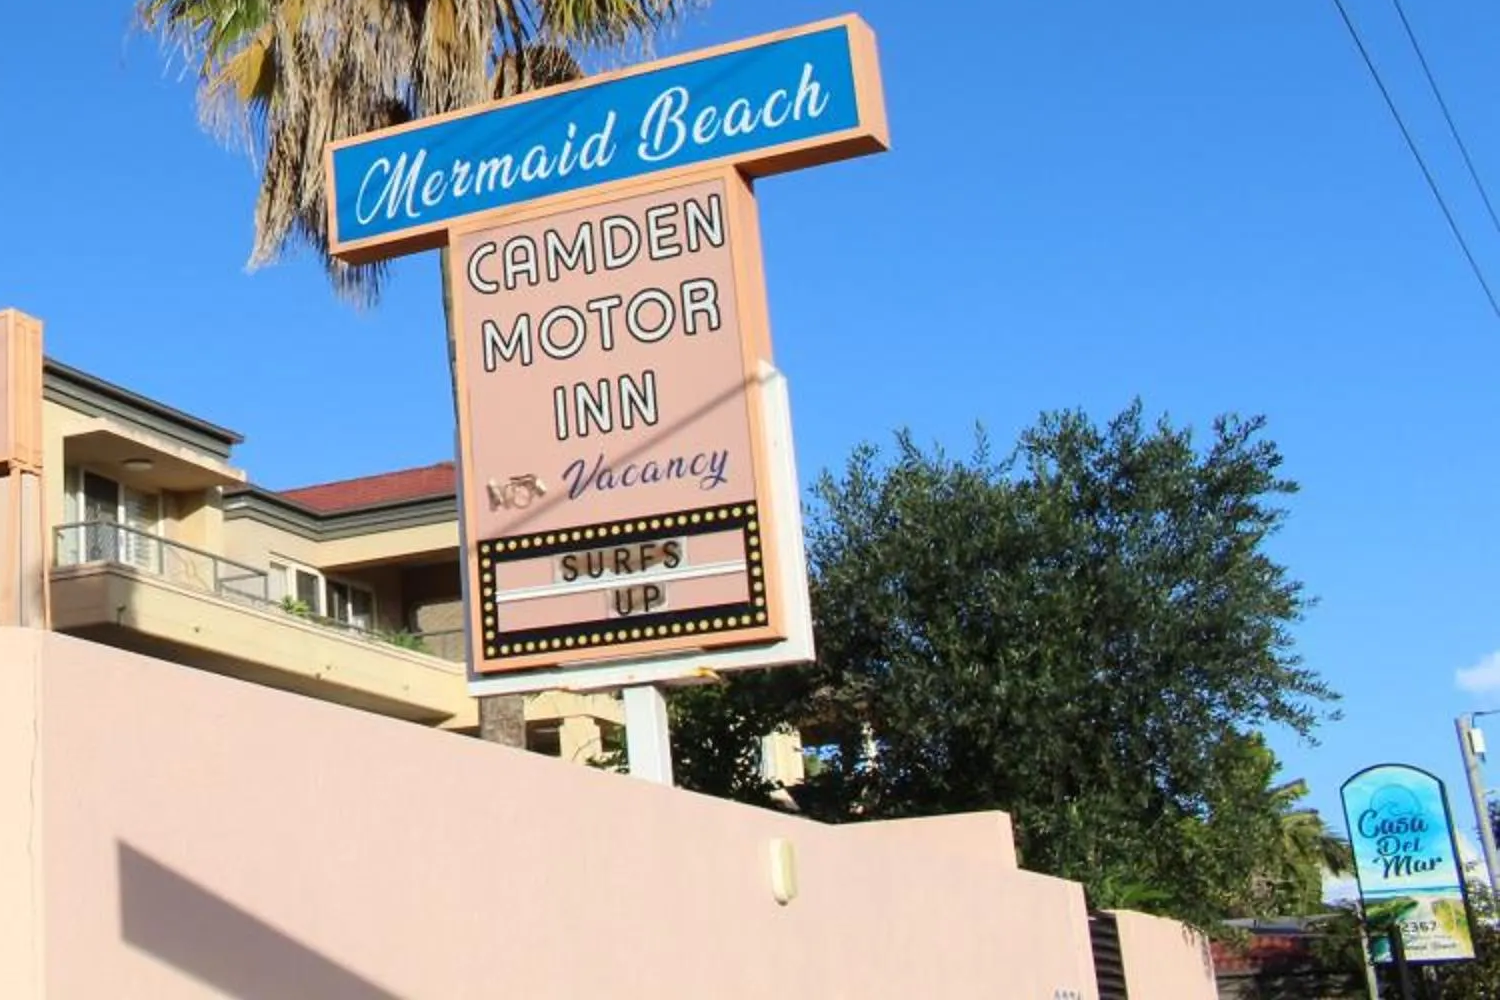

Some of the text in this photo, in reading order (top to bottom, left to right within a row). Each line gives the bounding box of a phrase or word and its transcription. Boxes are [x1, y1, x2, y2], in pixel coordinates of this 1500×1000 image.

[355, 62, 830, 226] Mermaid Beach
[467, 193, 725, 295] CAMDEN
[481, 277, 721, 373] MOTOR
[554, 370, 659, 441] INN
[562, 449, 729, 501] Vacancy
[561, 541, 682, 583] SURFS
[615, 585, 661, 616] UP
[1358, 809, 1429, 839] Casa
[1376, 835, 1422, 856] Del
[1371, 855, 1442, 879] Mar
